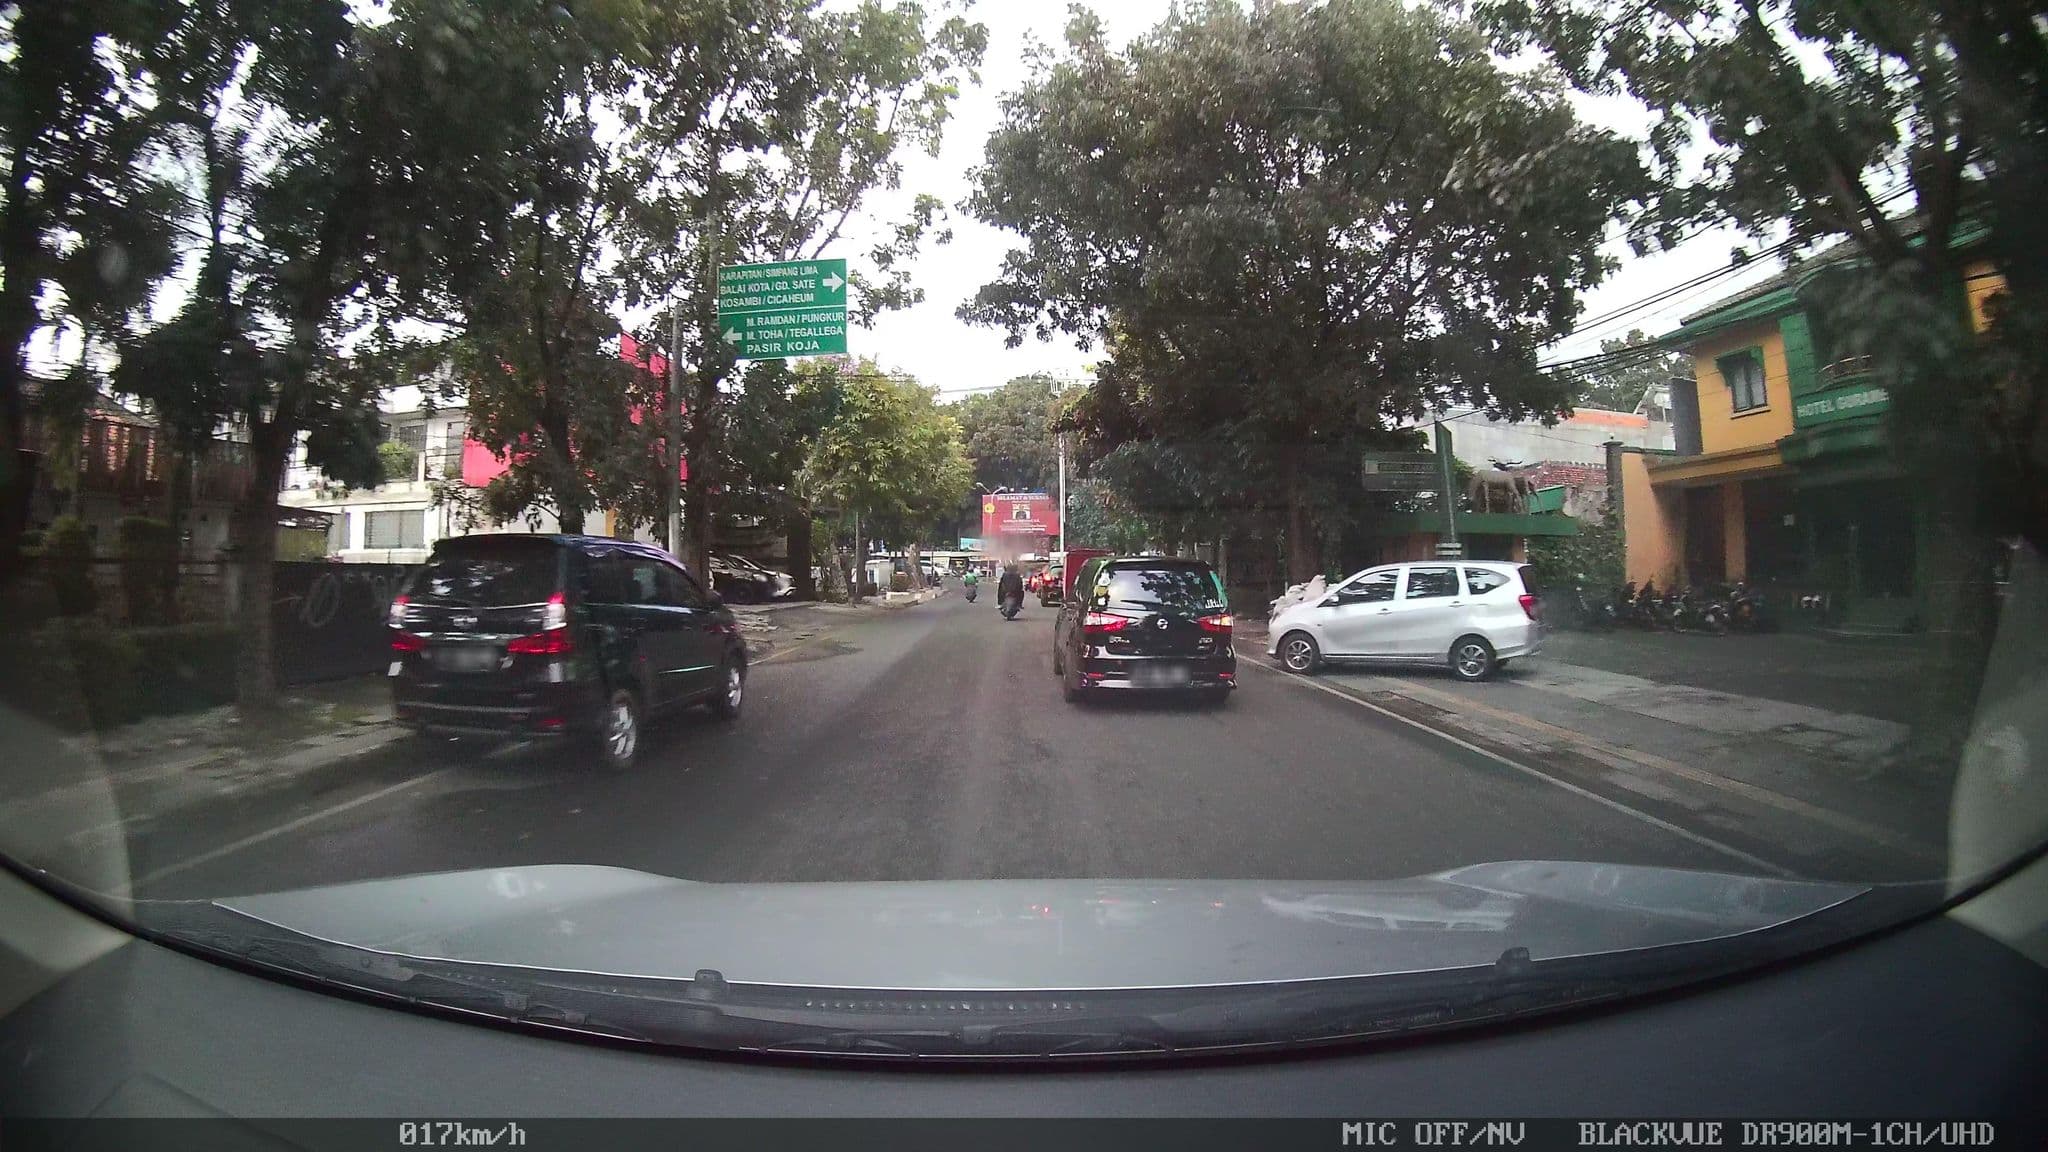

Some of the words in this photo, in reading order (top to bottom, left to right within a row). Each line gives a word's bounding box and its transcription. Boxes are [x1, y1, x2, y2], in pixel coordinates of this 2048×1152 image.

[800, 266, 818, 276] LIMA
[720, 284, 746, 295] BALAI
[792, 280, 815, 290] SATE
[746, 343, 782, 354] PASIR
[786, 341, 820, 352] KOJA
[1797, 399, 1835, 418] HOTEL
